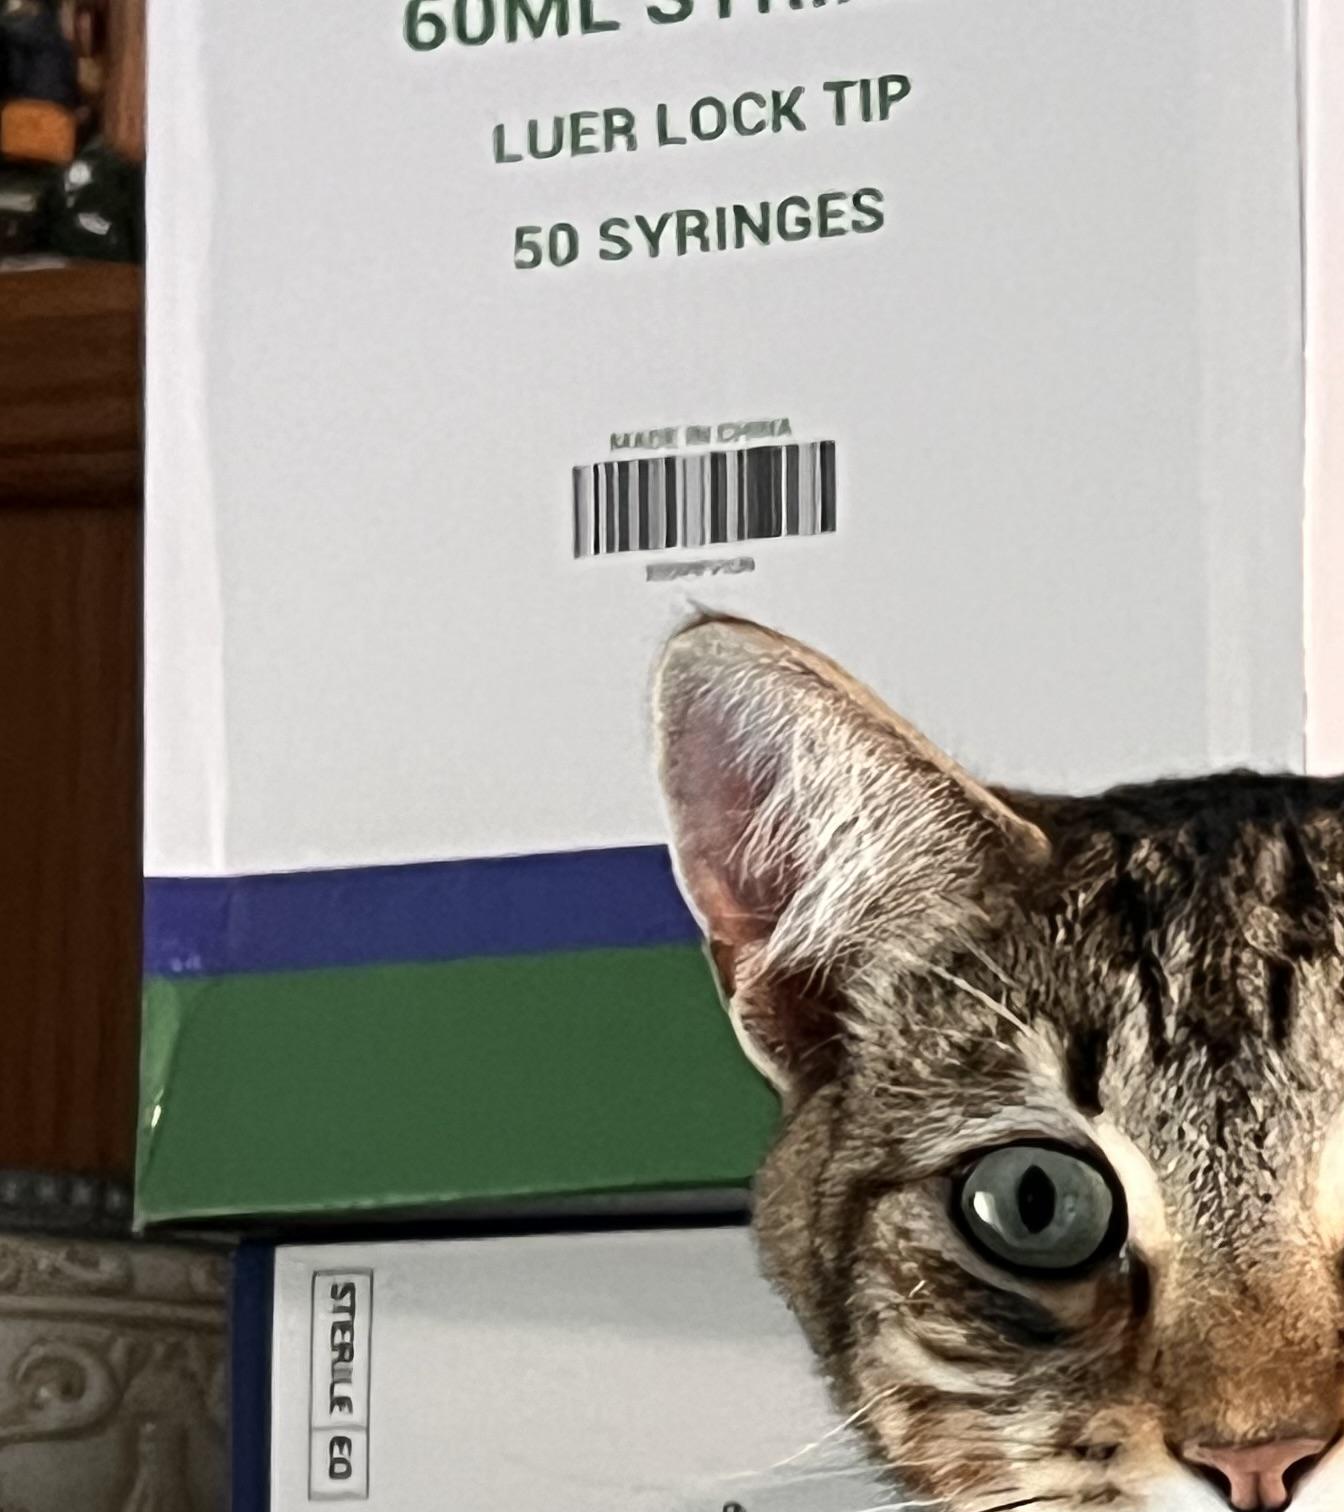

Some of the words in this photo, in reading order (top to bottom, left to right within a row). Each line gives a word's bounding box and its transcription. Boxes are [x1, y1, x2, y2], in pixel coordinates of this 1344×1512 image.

[403, 0, 620, 51] 60ML
[492, 107, 638, 164] LUER
[656, 86, 807, 146] LOCK
[823, 74, 913, 126] TIP
[512, 222, 580, 270] 50
[598, 187, 886, 261] SYRINGES
[330, 1282, 356, 1415] STERILE
[328, 1436, 353, 1480] EO
